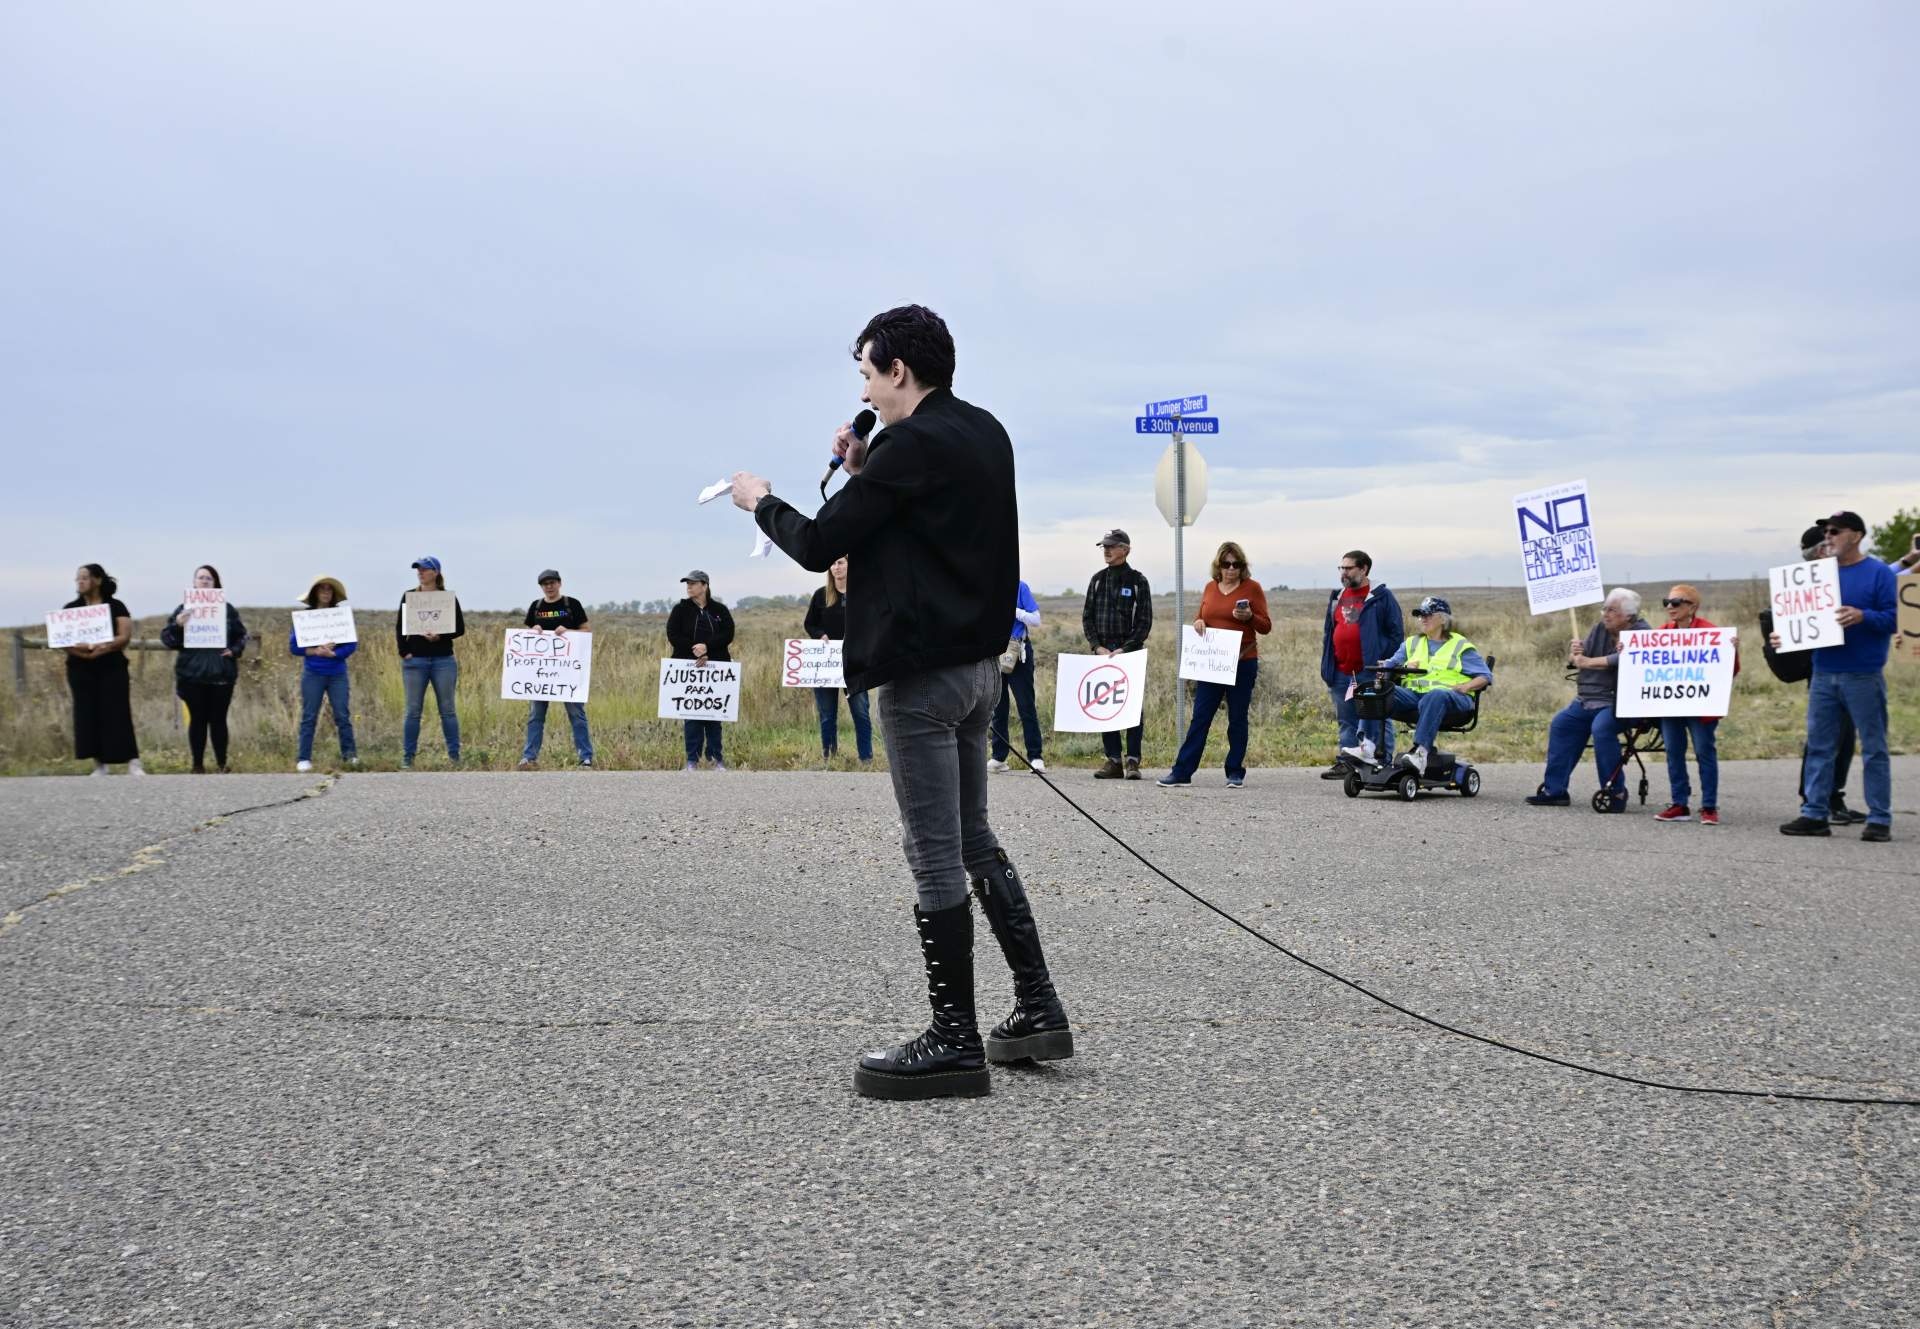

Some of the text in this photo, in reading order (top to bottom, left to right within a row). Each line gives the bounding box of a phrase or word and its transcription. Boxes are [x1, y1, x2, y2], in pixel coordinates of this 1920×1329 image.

[1149, 398, 1203, 417] N Juniper Street
[1141, 419, 1214, 432] E 30th Avenue
[1517, 493, 1589, 541] NO
[1523, 527, 1592, 554] CONCENTRATION
[1525, 542, 1587, 567] CAMPS IN
[1782, 563, 1822, 588] ICE
[184, 590, 224, 604] HANDS
[1774, 584, 1834, 617] SHAMES
[48, 607, 107, 623] TYRANNY
[192, 606, 218, 619] OFF
[1789, 616, 1820, 644] US
[510, 633, 566, 656] STOP
[1629, 631, 1721, 648] AUSCHWITZ
[506, 653, 581, 670] PROFITTING
[1628, 648, 1720, 665] TREBLINKA
[536, 667, 559, 678] from
[1644, 667, 1705, 682] DACHAU
[511, 681, 577, 697] CRUELTY
[684, 685, 714, 694] PARA
[1086, 680, 1125, 705] ICE
[1641, 684, 1710, 699] HUDSON
[671, 694, 731, 713] TODOS!
